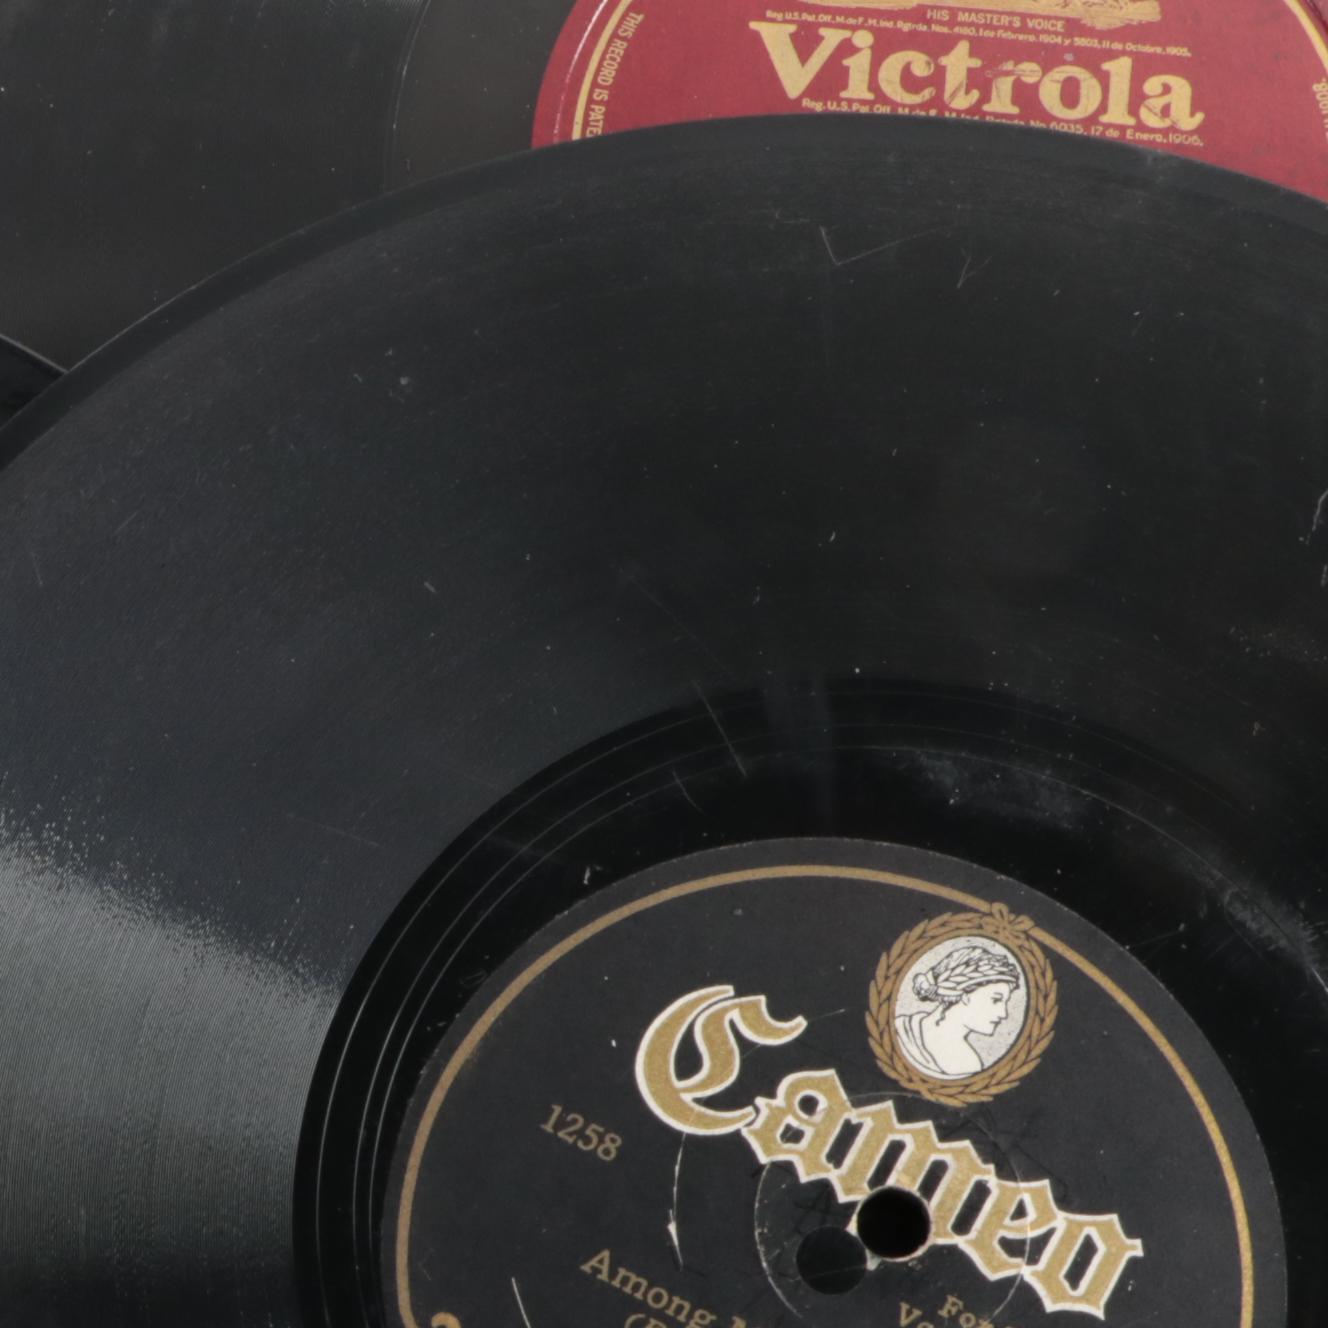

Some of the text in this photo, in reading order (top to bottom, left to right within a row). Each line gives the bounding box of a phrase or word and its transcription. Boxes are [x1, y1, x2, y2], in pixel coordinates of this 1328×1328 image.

[617, 11, 645, 39] THIS
[926, 8, 1065, 32] HIS MASTER'S VOICE
[597, 38, 629, 86] RECORD
[748, 20, 1206, 131] Victrola
[592, 88, 610, 102] IS
[801, 97, 827, 113] Reg.
[539, 1103, 622, 1162] 1258
[634, 984, 1145, 1320] Cameo
